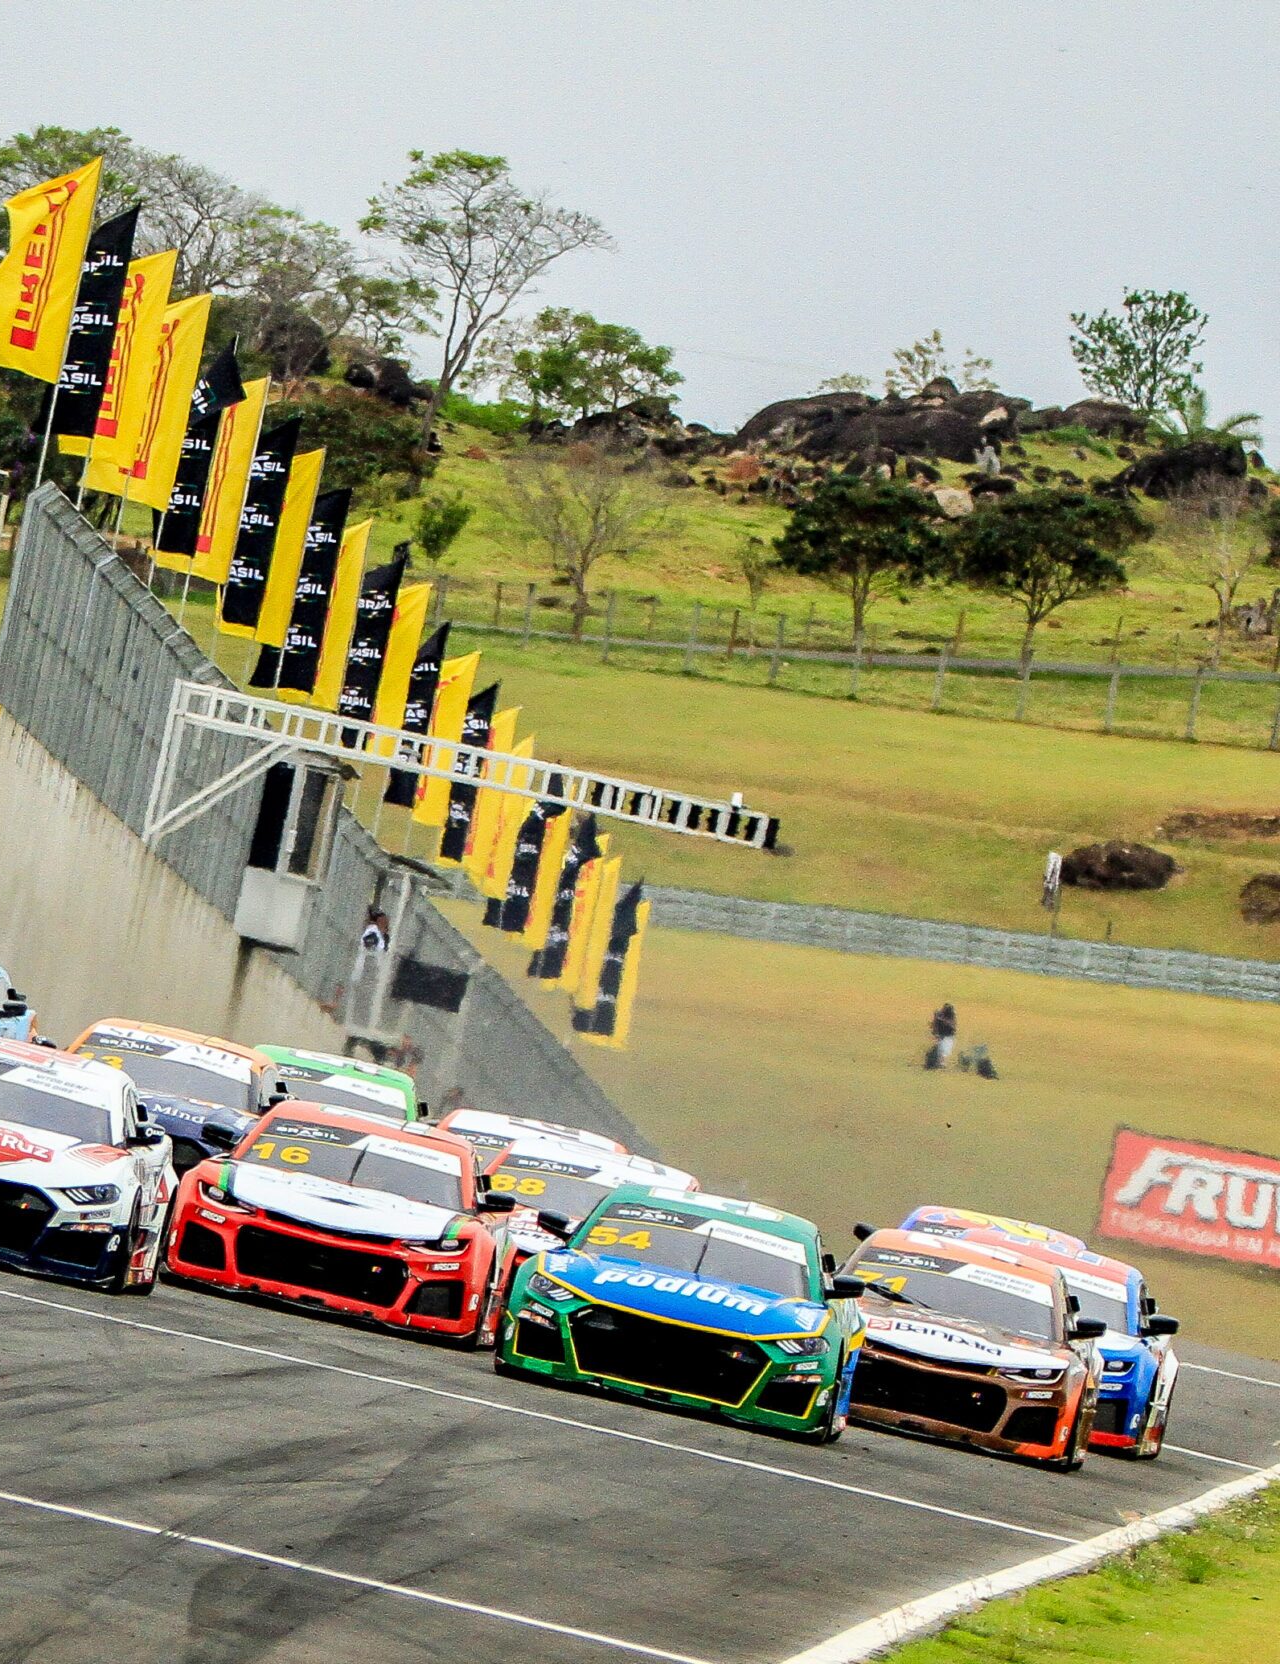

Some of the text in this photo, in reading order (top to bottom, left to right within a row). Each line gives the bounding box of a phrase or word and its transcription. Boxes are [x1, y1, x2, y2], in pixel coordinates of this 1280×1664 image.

[71, 313, 114, 326] ASIL
[60, 370, 103, 386] ASIL
[251, 460, 286, 473] ASIL
[240, 513, 274, 527] ASIL
[306, 532, 337, 544] ASIL
[229, 564, 264, 580] ASIL
[152, 1103, 206, 1125] Mind
[276, 1126, 341, 1141] BRASIL
[252, 1142, 312, 1165] 16
[518, 1158, 579, 1174] BRASIL
[490, 1173, 546, 1196] 88
[1115, 1147, 1280, 1236] FRU
[618, 1208, 685, 1224] BRASIL
[587, 1225, 652, 1250] 54
[877, 1253, 941, 1269] BRASIL
[593, 1268, 770, 1316] podium
